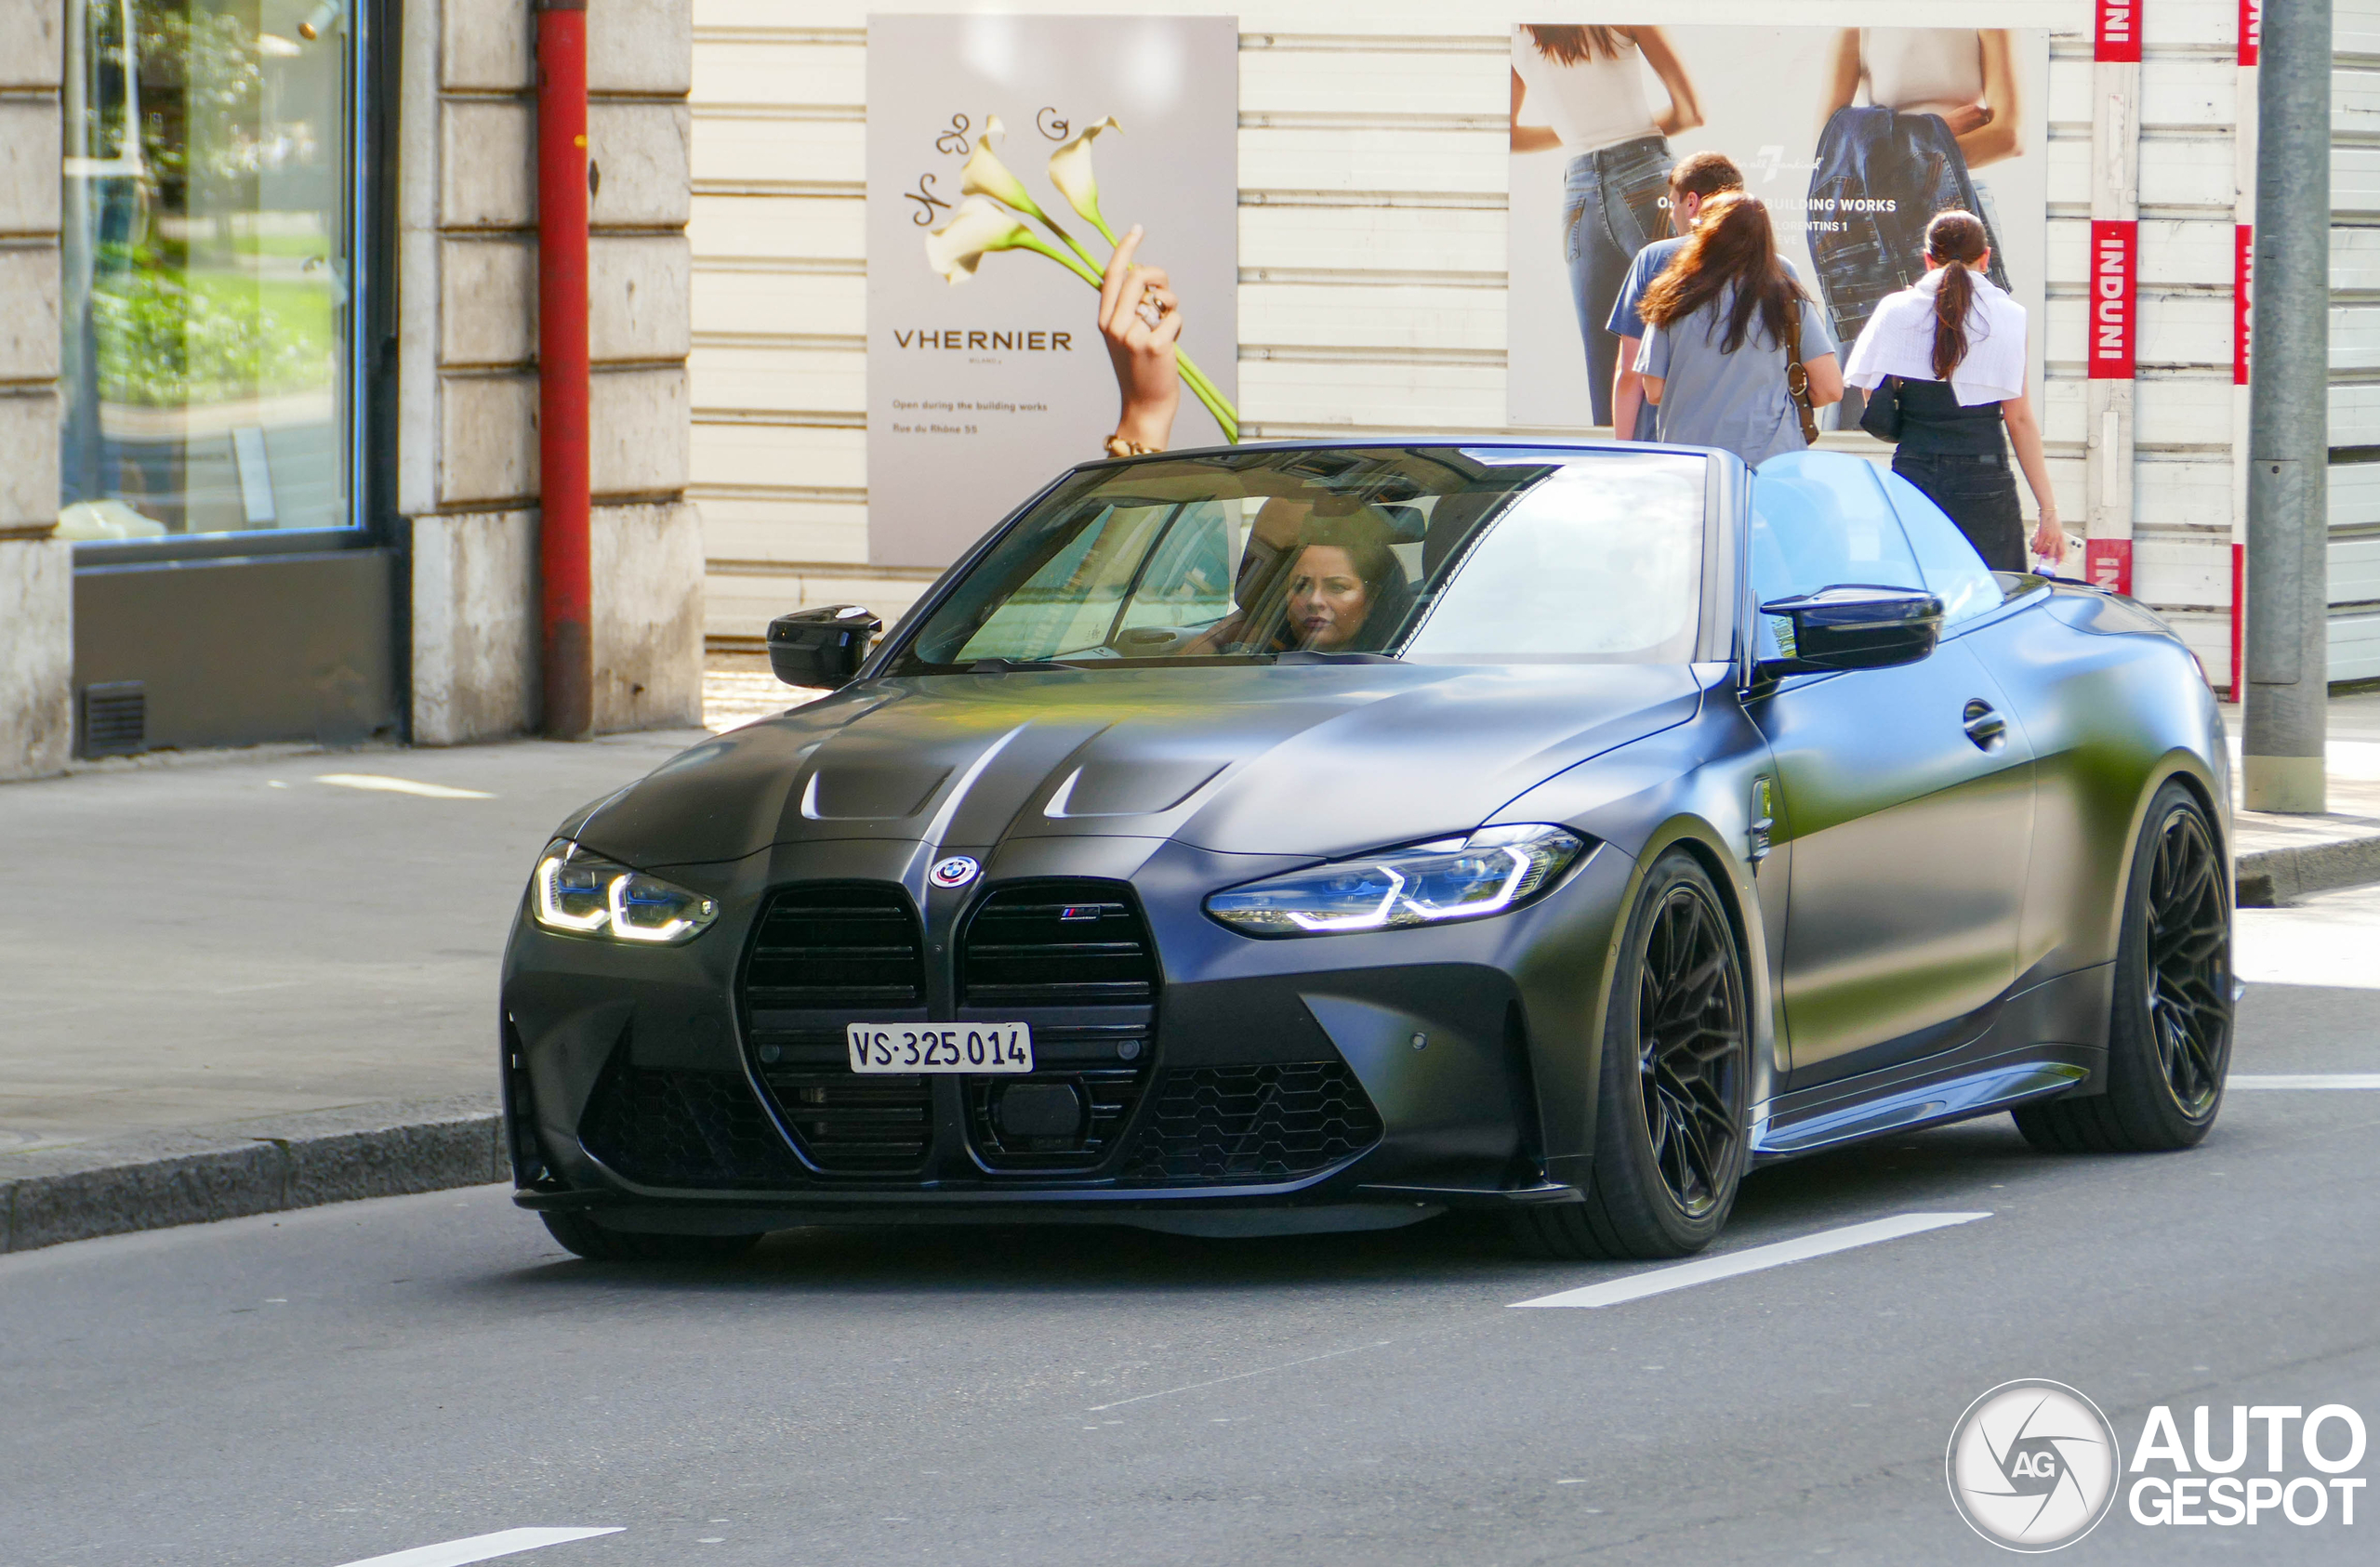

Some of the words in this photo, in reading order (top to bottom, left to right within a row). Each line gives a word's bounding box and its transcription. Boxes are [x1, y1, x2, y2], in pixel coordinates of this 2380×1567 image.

[1765, 198, 1836, 211] BUILDING
[1840, 198, 1897, 212] WORKS
[1771, 220, 1840, 231] LORENTINS
[1842, 221, 1848, 231] 1
[2098, 239, 2124, 359] INDUNI
[893, 329, 1073, 350] VHERNIER
[892, 400, 919, 410] Open
[922, 400, 954, 412] during
[958, 401, 972, 410] the
[976, 401, 1016, 413] building
[1020, 402, 1048, 412] works
[892, 424, 911, 433] Rue
[915, 424, 927, 433] du
[964, 425, 978, 435] 55
